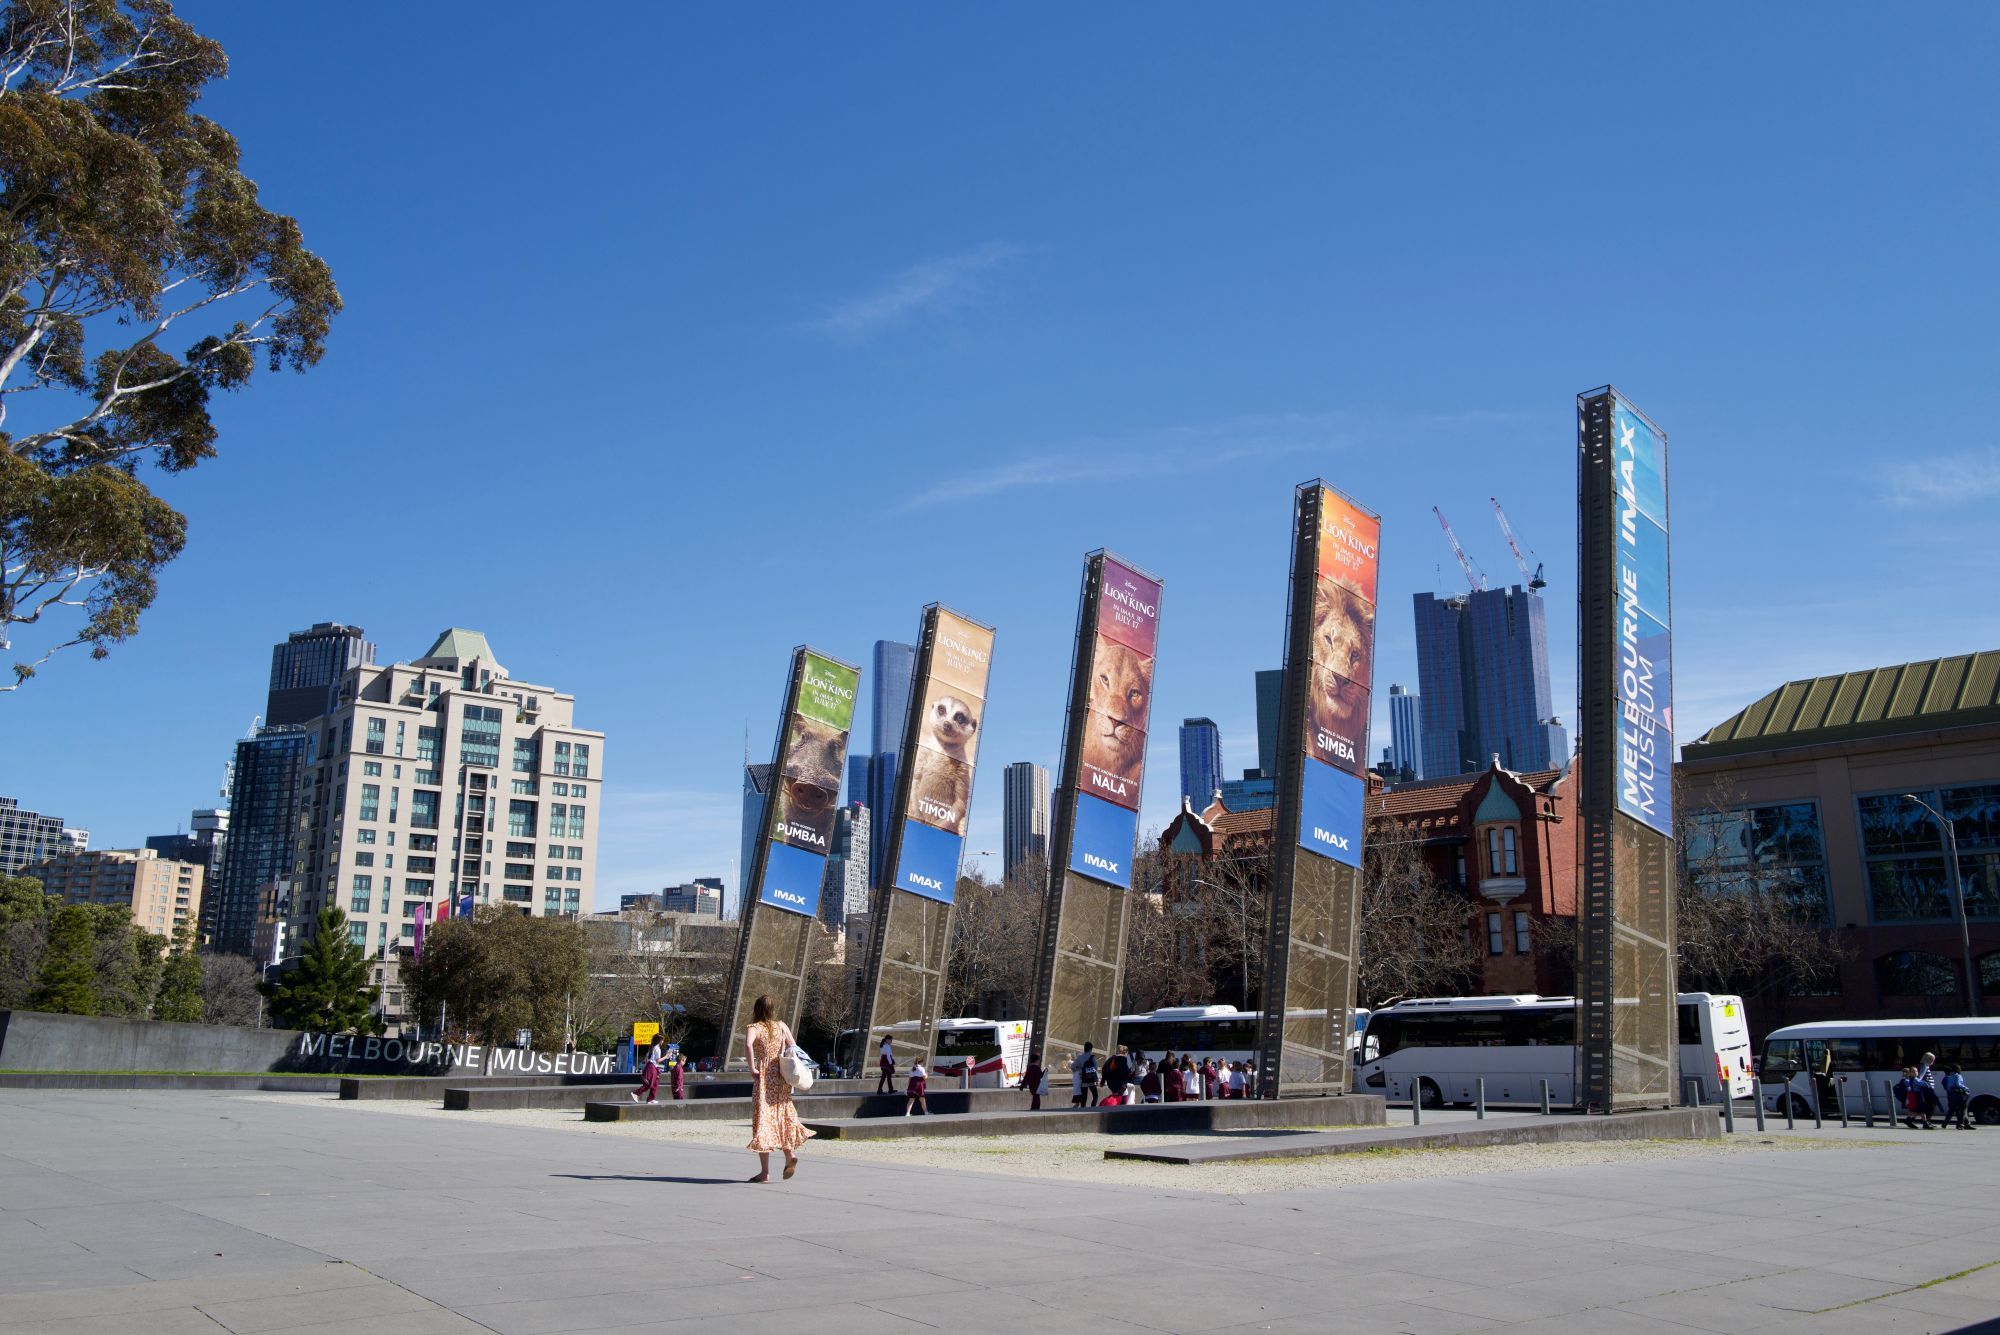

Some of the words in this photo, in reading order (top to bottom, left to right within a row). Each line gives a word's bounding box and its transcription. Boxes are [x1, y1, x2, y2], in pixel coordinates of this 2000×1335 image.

[1620, 416, 1636, 546] IMAX
[1323, 517, 1347, 543] LION
[1348, 535, 1375, 559] KING
[1335, 551, 1350, 567] JULY
[1104, 582, 1128, 605] LION
[1129, 597, 1155, 618] KING
[1115, 612, 1131, 625] JULY
[1132, 620, 1140, 629] 17
[937, 631, 960, 652] LION
[961, 645, 987, 663] KING
[805, 673, 827, 690] LION
[828, 684, 853, 700] KING
[1623, 565, 1638, 806] MELBOURNE
[814, 696, 829, 707] JULY
[1317, 732, 1355, 763] SIMBA
[1639, 655, 1655, 816] MUSEUM
[1092, 772, 1126, 797] NALA
[918, 799, 956, 823] TIMON
[777, 822, 825, 847] PUMBAA
[1313, 826, 1348, 851] IMAX
[1084, 852, 1118, 874] IMAX
[909, 872, 943, 891] IMAX
[773, 889, 806, 905] IMAX
[300, 1032, 481, 1068] MELBOURNE
[494, 1048, 609, 1075] MUSEUM
